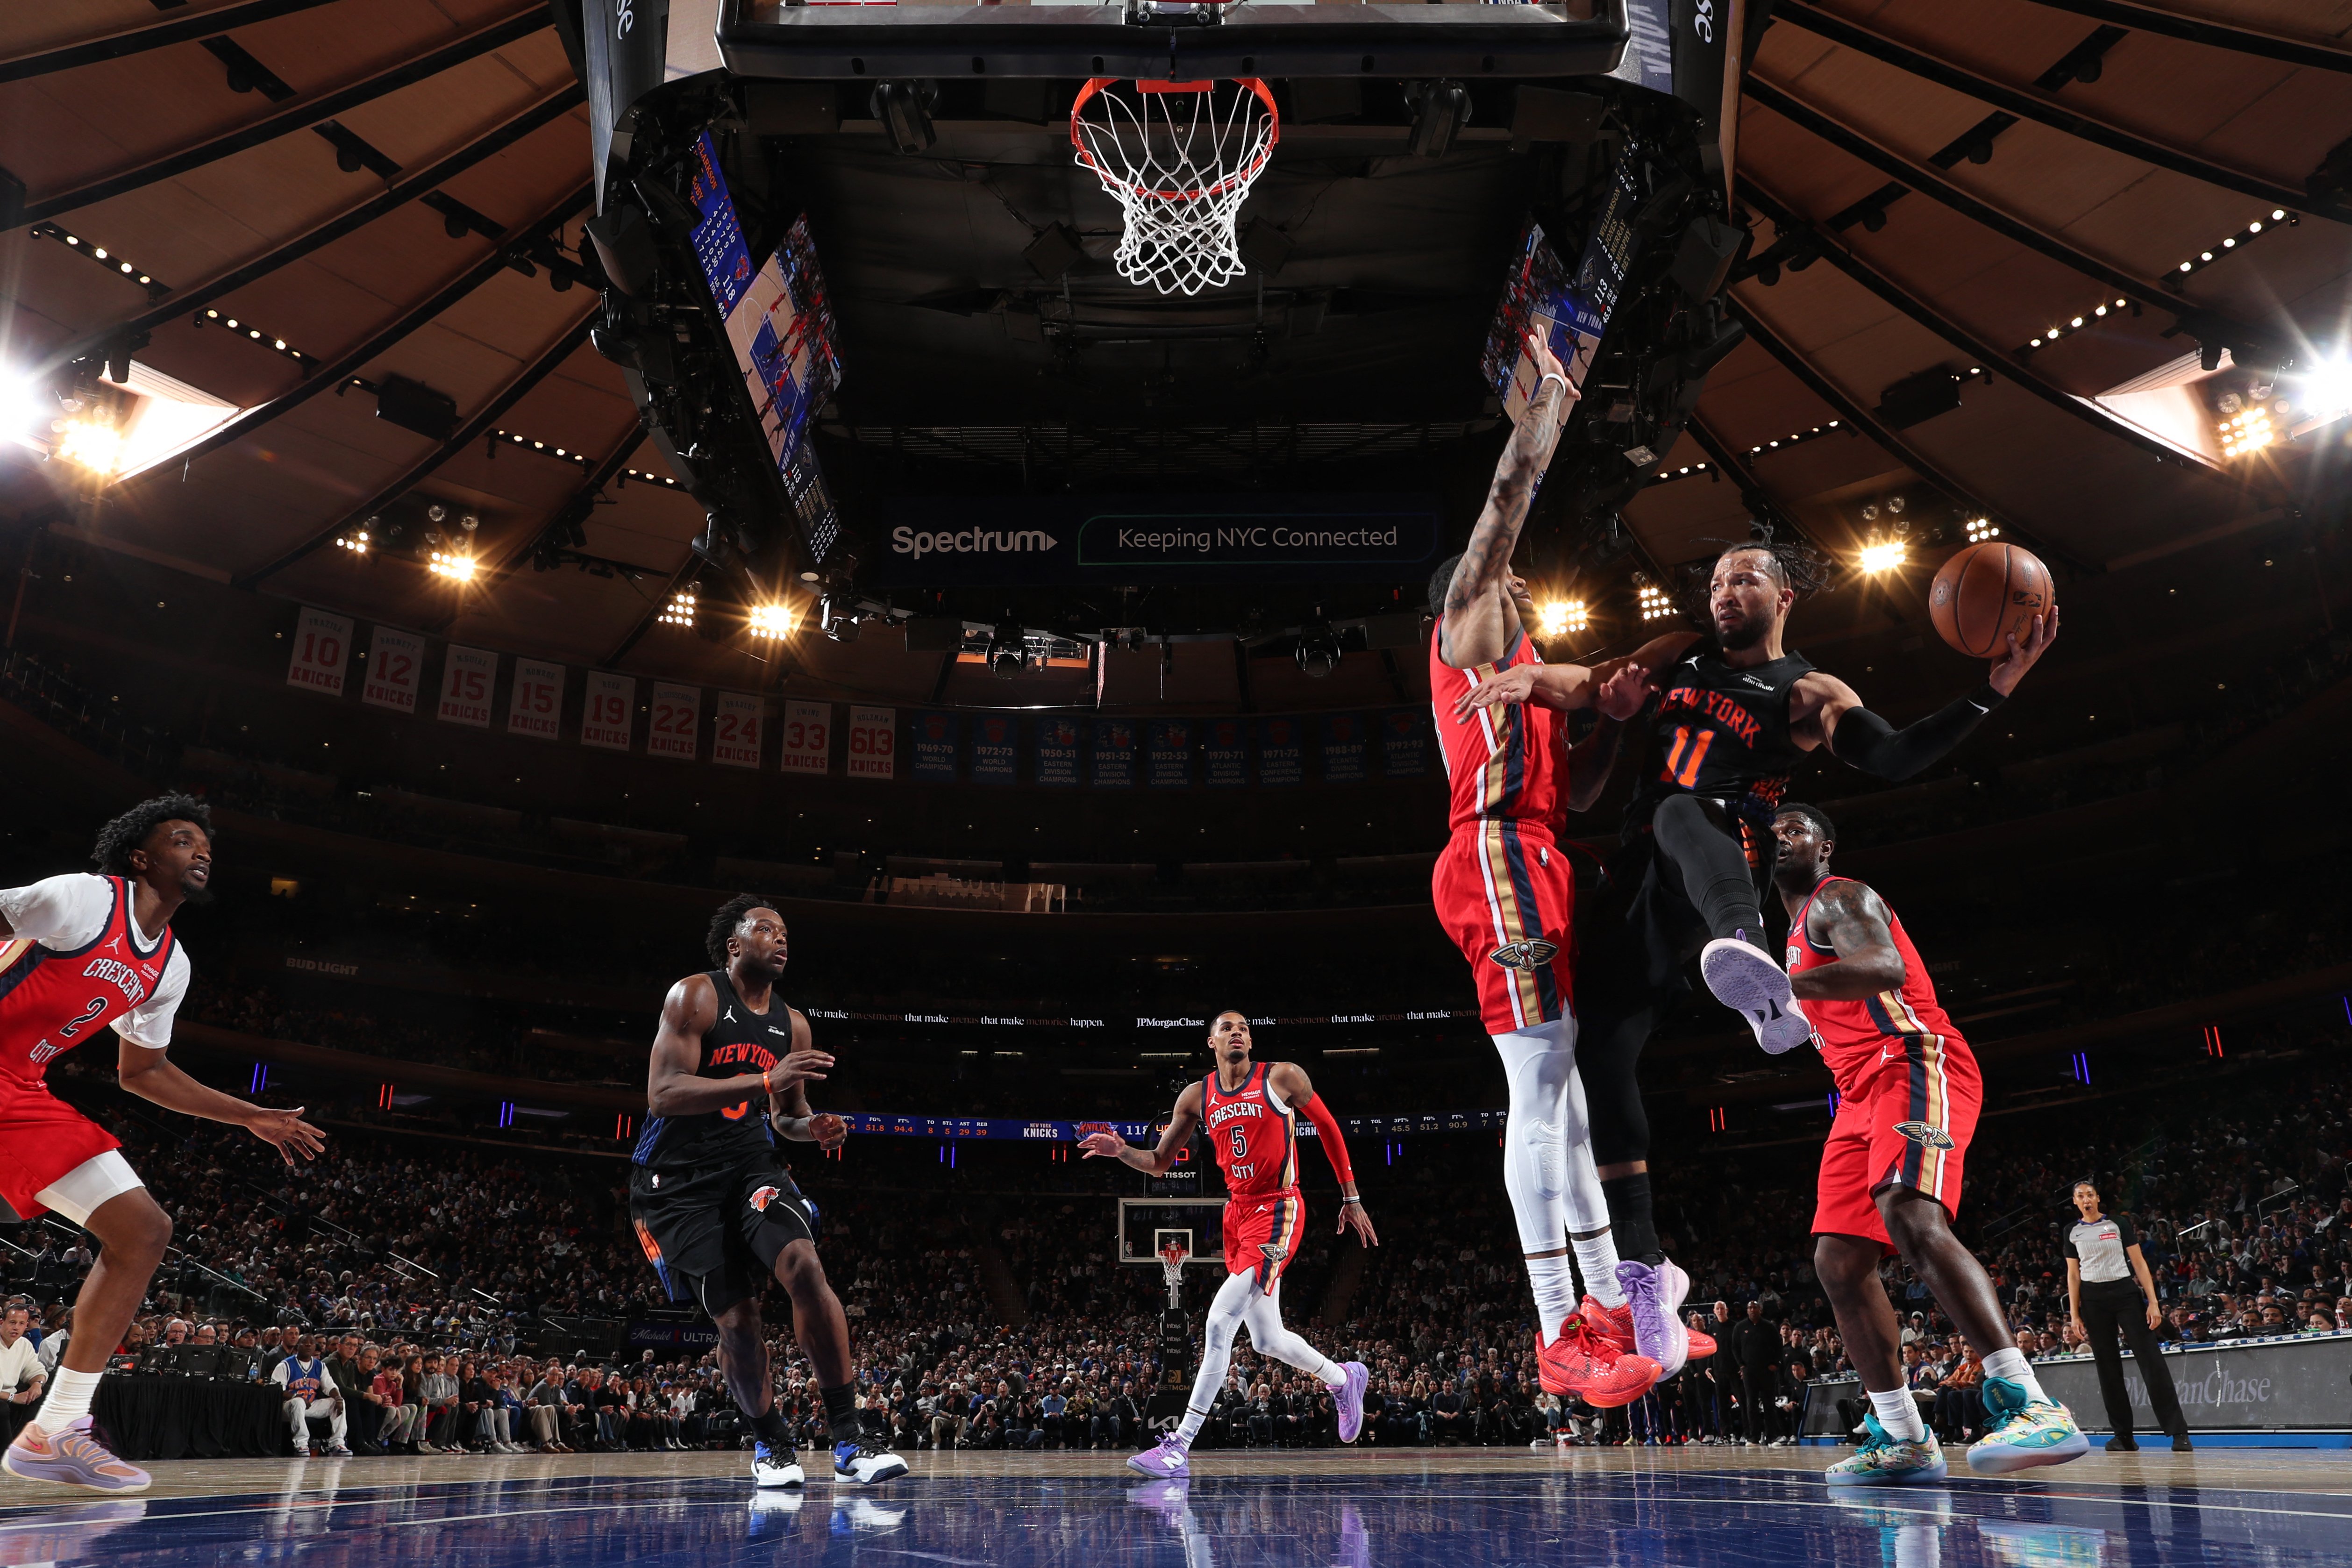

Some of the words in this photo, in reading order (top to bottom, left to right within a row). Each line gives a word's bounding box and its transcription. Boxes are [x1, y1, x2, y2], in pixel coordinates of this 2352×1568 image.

[698, 142, 717, 190] CLARKSON
[1599, 187, 1621, 237] WILLIAMSON
[1604, 219, 1618, 246] JONES
[1610, 219, 1626, 255] MURRAY
[1602, 245, 1607, 253] 2
[1612, 261, 1618, 274] 25
[1616, 228, 1632, 264] MURPHY
[1618, 270, 1624, 281] 41
[1621, 253, 1631, 271] BEY
[722, 274, 736, 301] 118
[1595, 278, 1608, 305] 113
[718, 302, 727, 320] 45.9
[1576, 311, 1588, 324] NEW
[1602, 306, 1612, 324] 45.9
[791, 463, 802, 483] 113
[892, 526, 1046, 560] Spectrum
[1119, 527, 1210, 553] Keeping
[1218, 527, 1267, 548] NYC
[1272, 526, 1397, 548] Connected
[309, 618, 342, 633] FRAZIER
[302, 633, 340, 667] 10
[380, 637, 417, 652] BARNETT
[292, 666, 341, 689] KNICKS
[376, 651, 412, 686] 12
[526, 668, 556, 680] MONROE
[450, 669, 486, 701] 15
[366, 684, 413, 706] KNICKS
[520, 682, 554, 713] 15
[441, 702, 488, 722] KNICKS
[592, 694, 625, 725] 19
[797, 708, 820, 718] EWING
[856, 714, 889, 724] HOLZMAN
[512, 714, 556, 734] KNICKS
[654, 704, 694, 736] 22
[719, 713, 757, 745] 24
[1704, 691, 1761, 749] YORK
[584, 727, 628, 745] KNICKS
[787, 721, 826, 750] 33
[850, 727, 893, 755] 613
[1386, 740, 1424, 750] 1992-93
[651, 737, 694, 754] KNICKS
[716, 745, 758, 763] KNICKS
[917, 743, 954, 754] 1969-70
[977, 746, 1013, 756] 1972-73
[1040, 748, 1076, 758] 1950-51
[1263, 748, 1299, 759] 1971-72
[1325, 745, 1363, 755] 1988-89
[784, 754, 826, 769] KNICKS
[1095, 751, 1131, 761] 1951-52
[1151, 751, 1188, 760] 1952-53
[1208, 751, 1244, 760] 1970-71
[1390, 751, 1420, 760] ATLANTIC
[1660, 725, 1717, 790] 11
[850, 759, 891, 774] KNICKS
[915, 763, 952, 771] CHAMPIONS
[1386, 767, 1425, 776] CHAMPIONS
[142, 963, 159, 978] NEWAGE
[286, 957, 316, 970] BUD
[317, 962, 358, 976] LIGHT
[82, 958, 145, 1008] CRESCENT
[59, 997, 108, 1038] 2
[808, 1008, 822, 1018] We
[824, 1010, 849, 1019] make
[850, 1010, 903, 1021] investments
[905, 1013, 923, 1023] that
[925, 1014, 949, 1024] make
[981, 1016, 998, 1025] that
[1000, 1017, 1024, 1026] make
[1070, 1018, 1105, 1028] happen.
[1136, 1017, 1205, 1029] JPMorganChase
[1252, 1016, 1276, 1026] make
[1278, 1016, 1330, 1025] investments
[1332, 1014, 1348, 1023] that
[1351, 1013, 1375, 1023] make
[1407, 1011, 1425, 1020] that
[1426, 1009, 1451, 1019] make
[29, 1039, 64, 1063] CITY
[708, 1043, 751, 1067] NEW
[1210, 1102, 1263, 1129] CRESCENT
[1023, 1128, 1057, 1138] KNICKS
[1230, 1125, 1247, 1158] 5
[1231, 1162, 1254, 1179] CITY
[631, 1327, 672, 1340] Michelob
[683, 1332, 720, 1343] ULTRA
